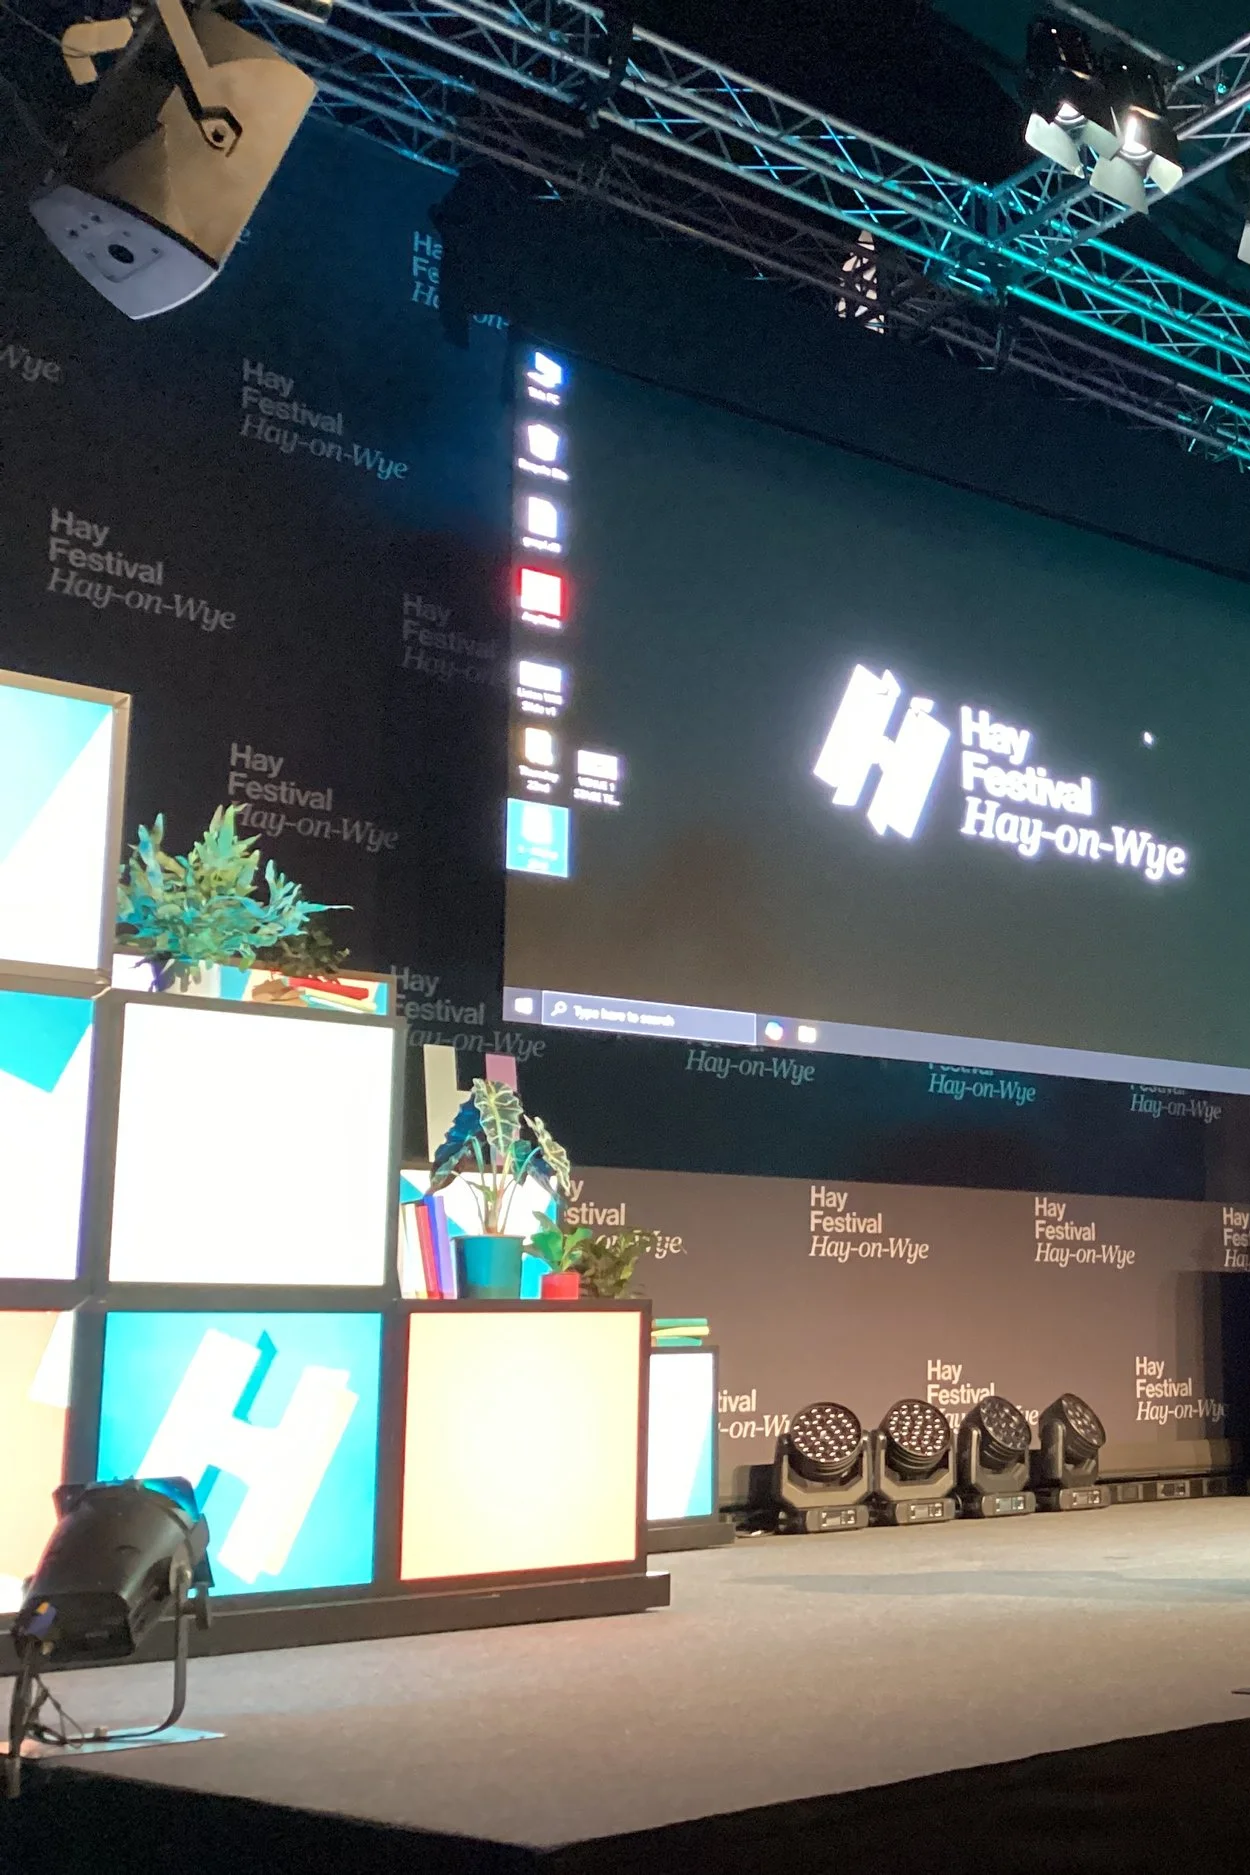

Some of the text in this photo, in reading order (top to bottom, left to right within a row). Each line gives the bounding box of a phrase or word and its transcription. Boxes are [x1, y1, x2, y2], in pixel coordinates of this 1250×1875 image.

[413, 230, 443, 260] Ha
[242, 357, 294, 398] Hay
[241, 385, 343, 436] Festival
[239, 413, 409, 480] Hay-on-Wye
[51, 507, 110, 547] Hay
[49, 535, 163, 585] Festival
[47, 567, 237, 632] Hay-on-Wye
[960, 705, 1032, 765] Hay
[230, 742, 285, 778] Hay
[228, 771, 333, 811] Festival
[960, 750, 1093, 816] Festival
[960, 795, 1187, 881] Hay-on-Wye
[391, 964, 440, 997] Hay
[404, 1023, 547, 1062] ay-on-Wye
[685, 1049, 815, 1085] Hay-on-Wye
[928, 1074, 1036, 1105] Hay-on-Wye
[1130, 1094, 1222, 1124] Hay-on-Wye
[564, 1202, 626, 1226] stival
[810, 1185, 848, 1212] Hay
[1034, 1197, 1066, 1221] Hay
[810, 1210, 882, 1234] Festival
[1034, 1219, 1096, 1241] Festival
[1222, 1207, 1250, 1230] Hay
[808, 1235, 929, 1265] Hay-on-Wye
[1034, 1242, 1135, 1269] Hay-on-Wye
[927, 1359, 962, 1385] Hay
[1135, 1356, 1165, 1379] Hay
[718, 1388, 757, 1413] tival
[1136, 1377, 1193, 1398] Festival
[137, 1328, 360, 1583] H
